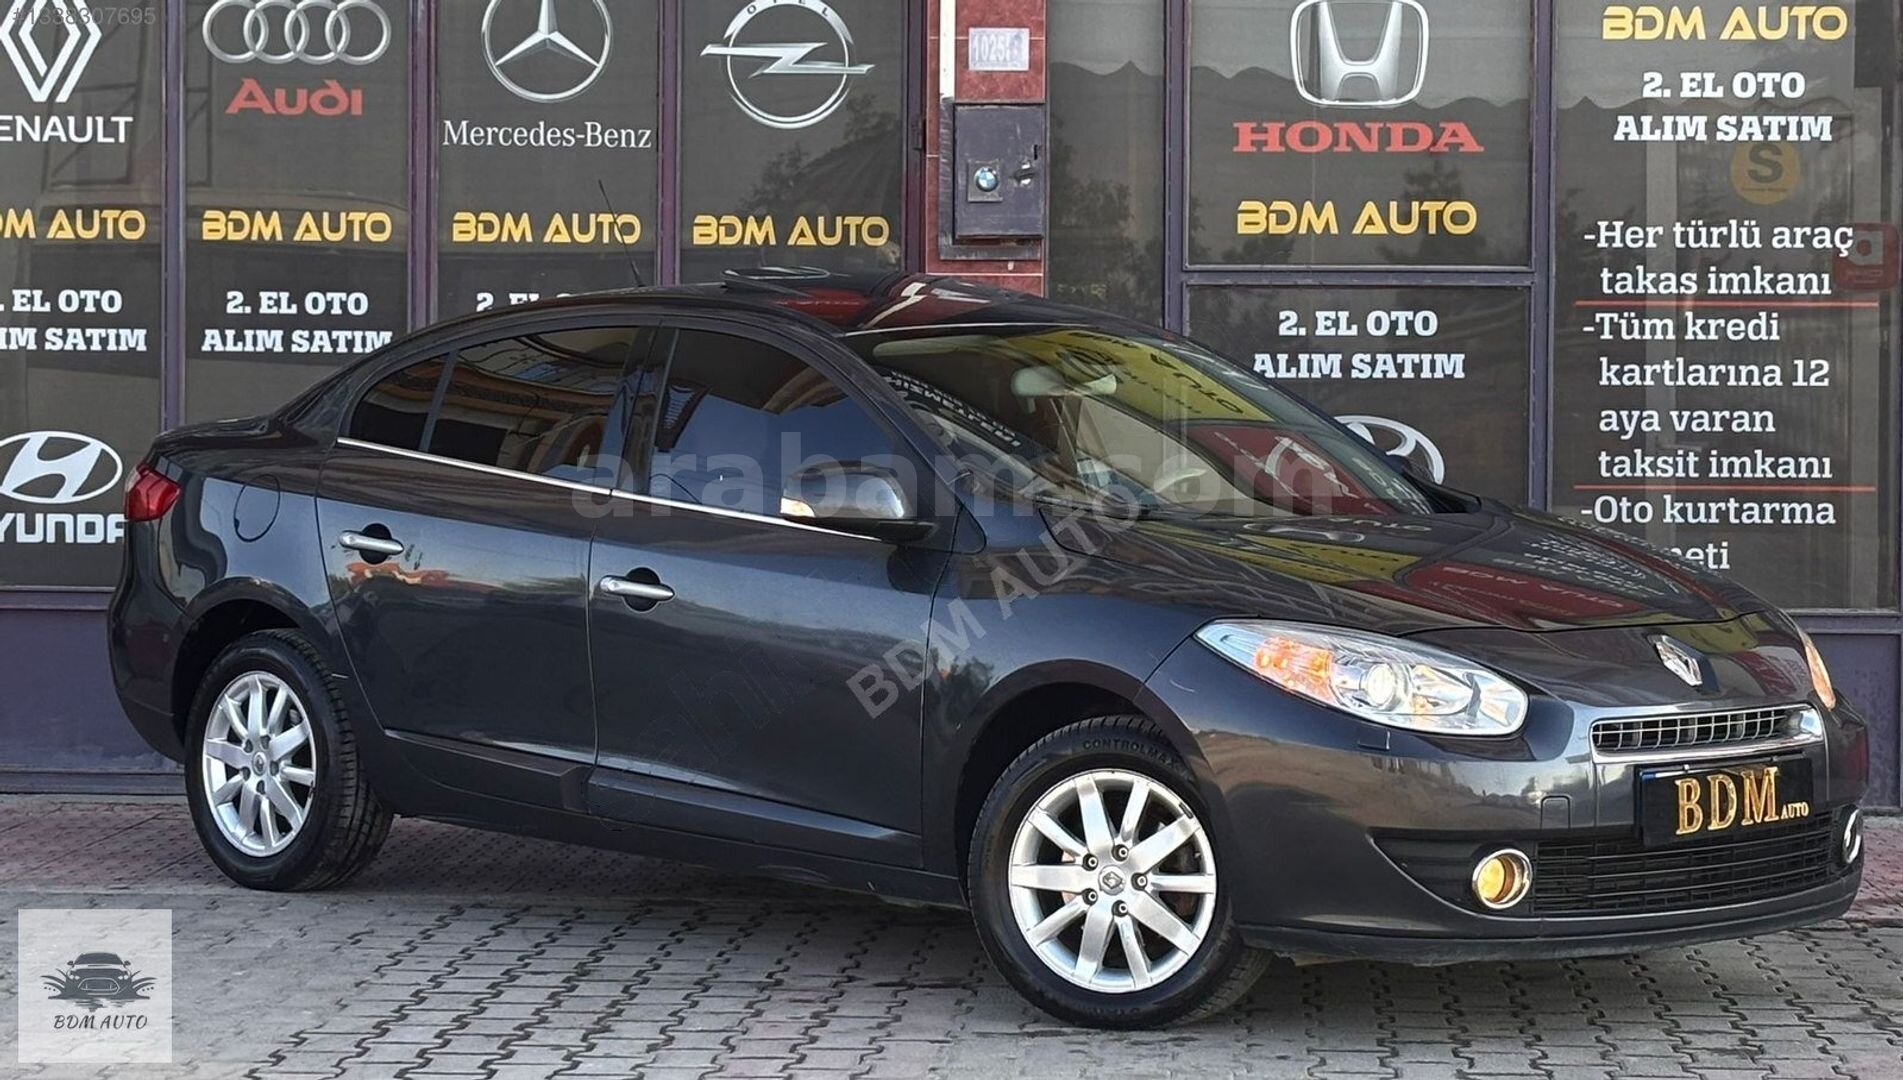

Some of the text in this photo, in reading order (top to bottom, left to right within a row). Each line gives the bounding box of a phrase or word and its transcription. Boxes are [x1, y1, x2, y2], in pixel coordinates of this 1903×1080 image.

[1603, 6, 1848, 40] BDM AUTO
[225, 77, 363, 116] Audi
[1642, 71, 1806, 99] 2. EL OTO
[0, 115, 134, 143] ENAULT
[443, 119, 652, 149] Mercedes-Benz
[1234, 121, 1483, 153] HONDA
[1613, 115, 1833, 142] ALIM SATIM
[46, 208, 146, 240] AUTO
[202, 210, 392, 242] BDM AUTO
[452, 211, 641, 244] BDM AUTO
[692, 214, 890, 247] BDM AUTO
[1236, 200, 1478, 235] BDM AUTO
[1583, 219, 1854, 257] -Her türlü araç
[1600, 265, 1698, 295] takas
[1707, 265, 1832, 295] imkanı
[12, 289, 123, 313] EL OTO
[226, 290, 369, 315] 2. EL OTO
[1278, 310, 1438, 337] 2. EL OTO
[1582, 311, 1780, 341] -Tüm kredi
[44, 327, 147, 351] SATIM
[201, 329, 393, 353] ALIM SATIM
[1253, 353, 1466, 379] ALIM SATIM
[1599, 356, 1831, 387] kartlarına 12
[1599, 410, 1776, 440] aya varan
[1598, 449, 1833, 478] taksit imkanı
[1581, 494, 1836, 525] -Oto kurtarma
[1675, 766, 1810, 836] BDM AUTO
